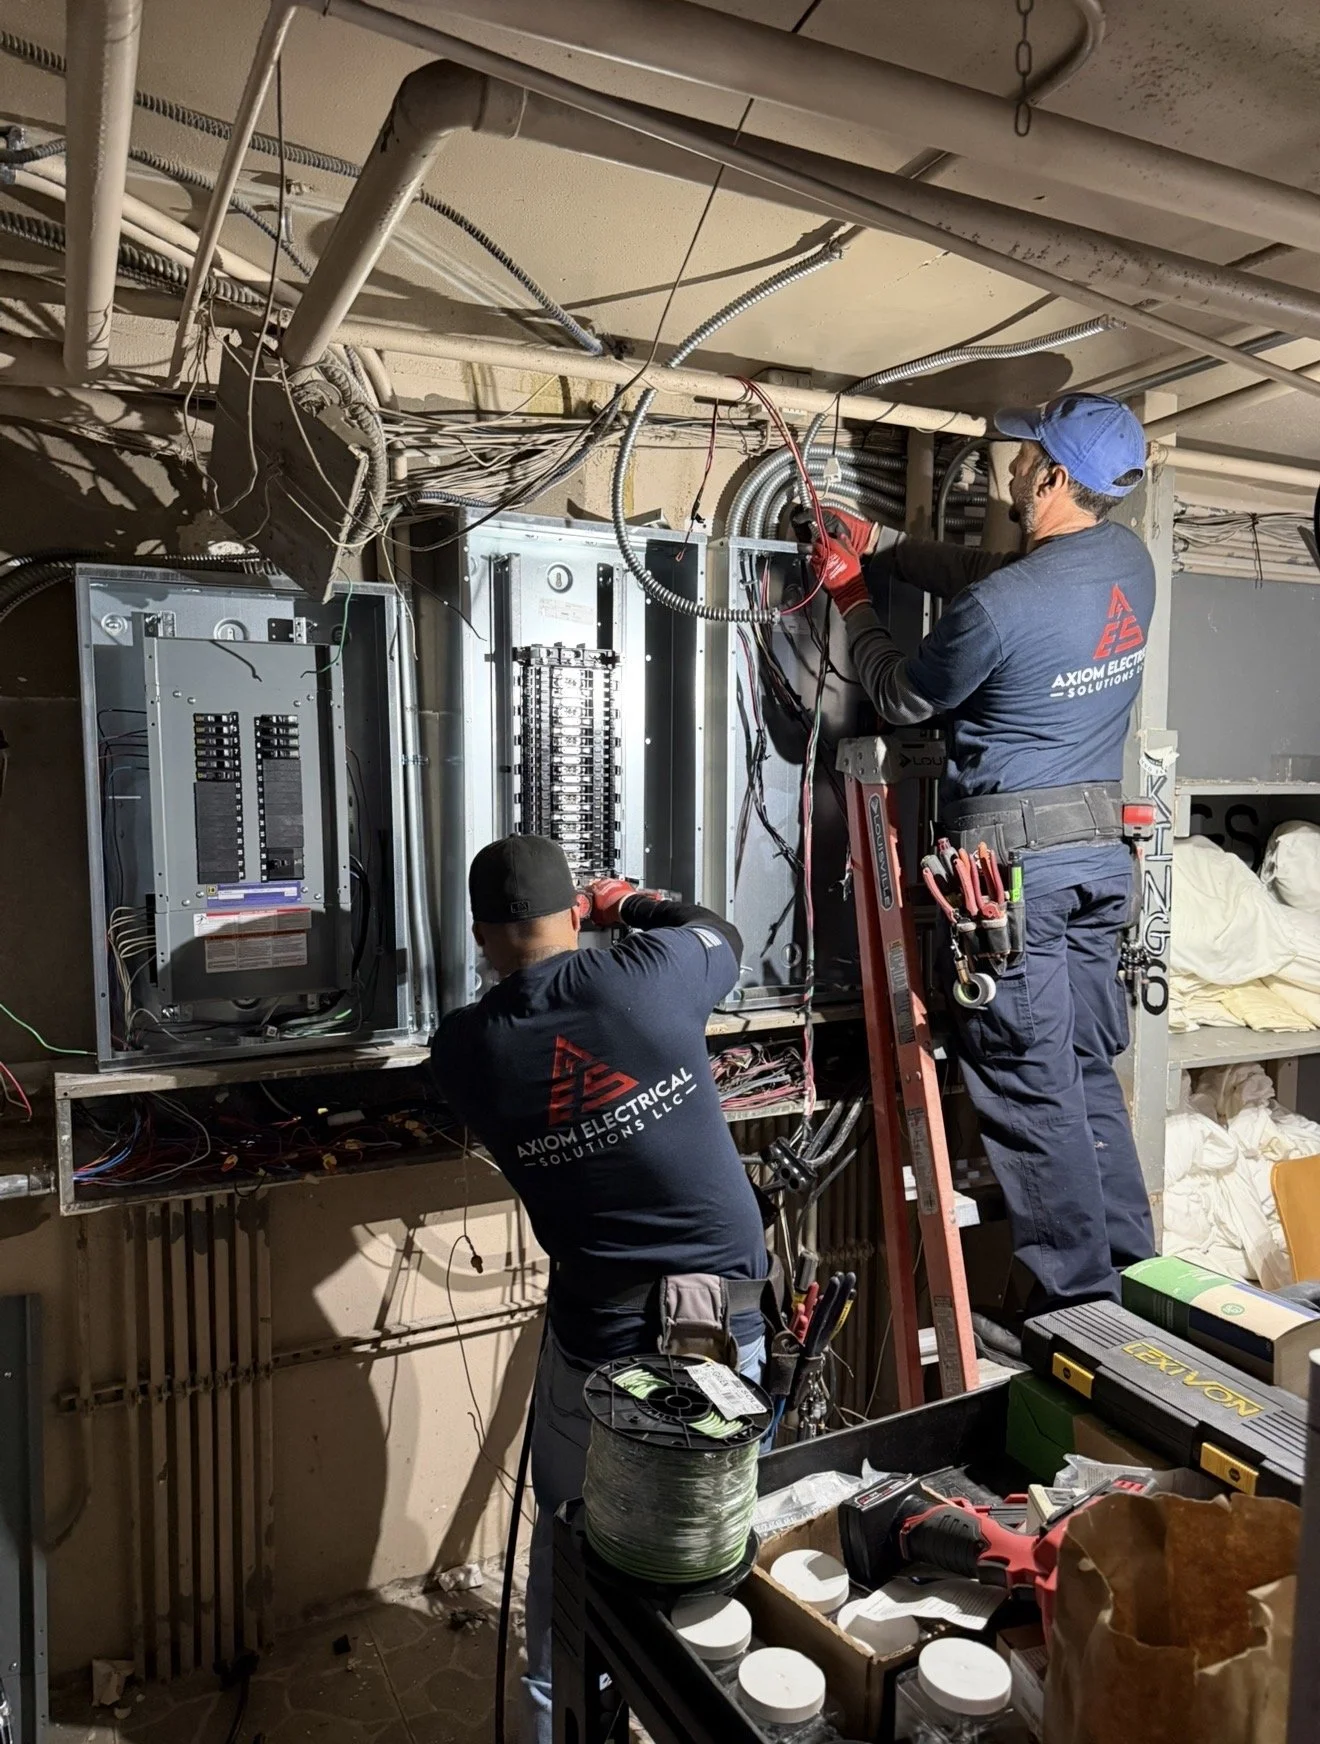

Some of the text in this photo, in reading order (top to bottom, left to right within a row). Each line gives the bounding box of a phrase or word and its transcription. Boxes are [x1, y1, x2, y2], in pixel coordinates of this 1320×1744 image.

[1051, 646, 1147, 689] AXIOM ELECTR
[1067, 669, 1135, 698] SOLUTIONS
[912, 756, 945, 766] LOU
[873, 815, 891, 906] LOUISVILLE
[516, 1067, 693, 1159] AXIOM ELECTRICAL
[539, 1093, 684, 1168] SOLUTIONS LLC
[1121, 1342, 1266, 1417] LEXIVON
